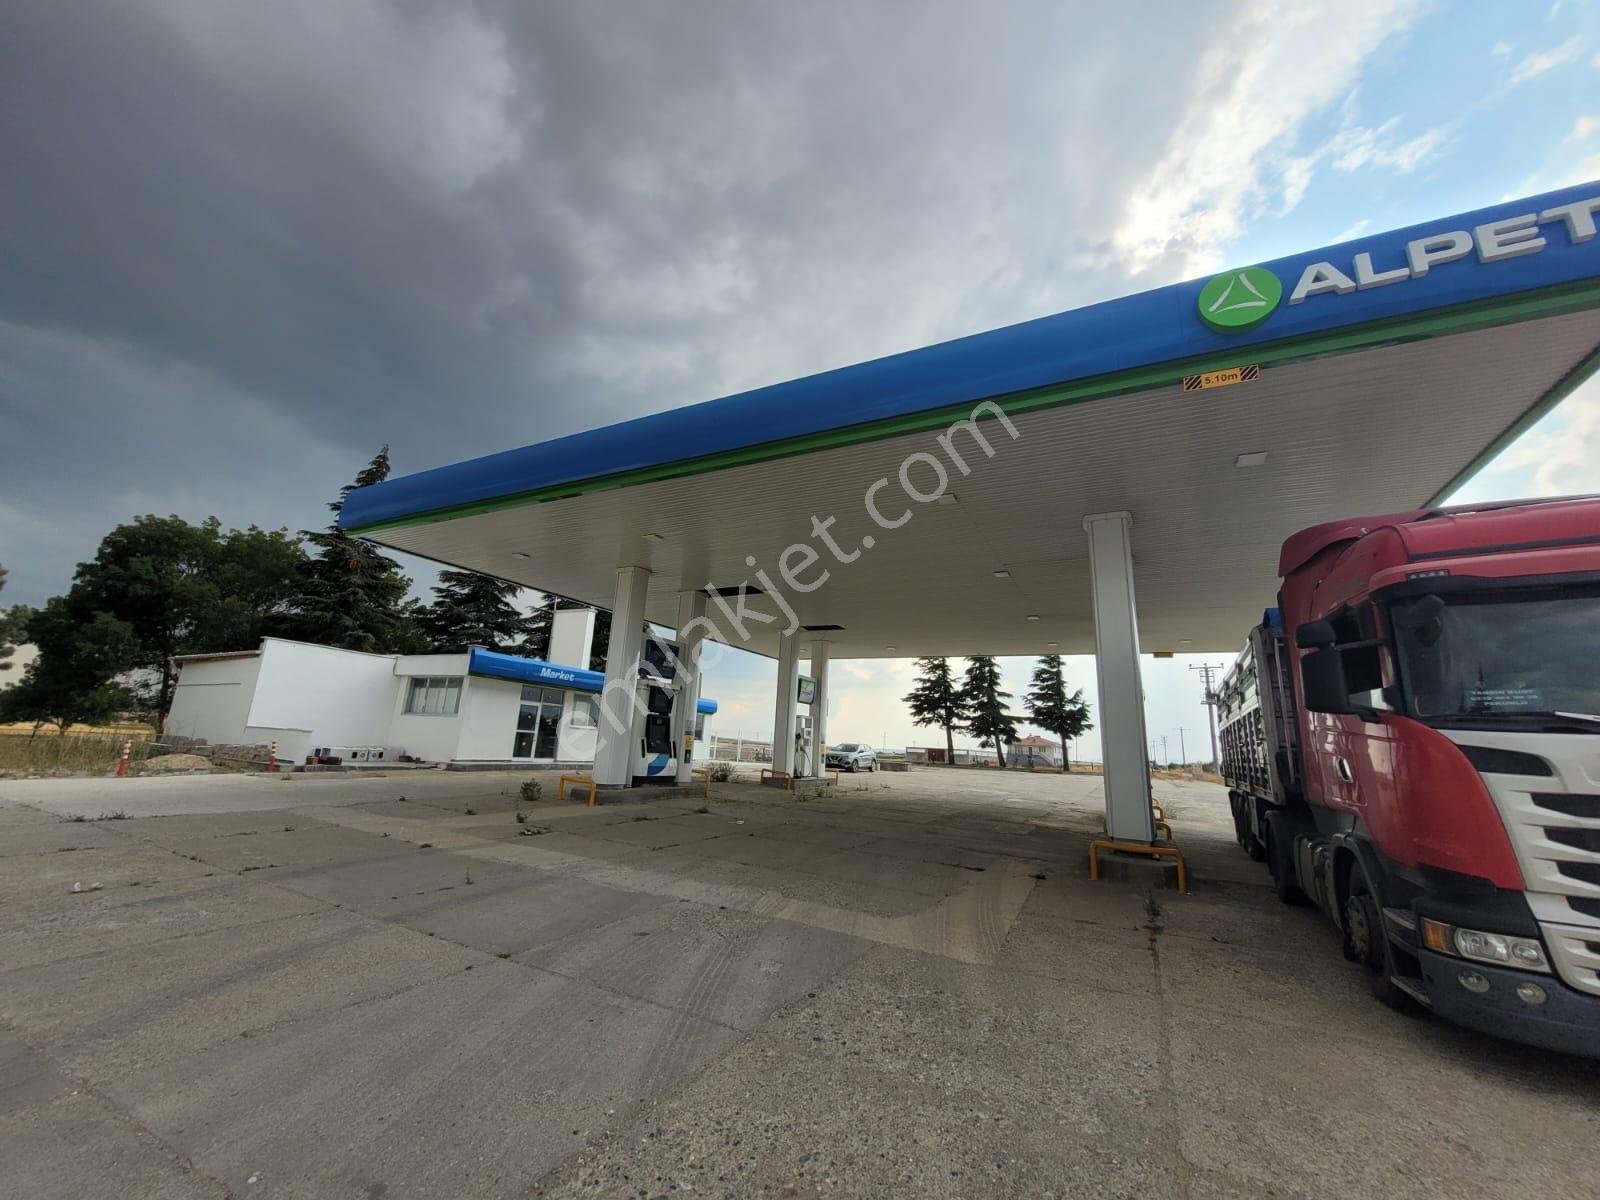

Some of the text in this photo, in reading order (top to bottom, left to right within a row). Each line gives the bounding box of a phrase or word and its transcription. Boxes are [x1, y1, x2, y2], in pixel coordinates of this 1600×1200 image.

[1289, 197, 1600, 304] ALPET
[1204, 373, 1238, 385] 5.10m
[540, 667, 576, 681] Market
